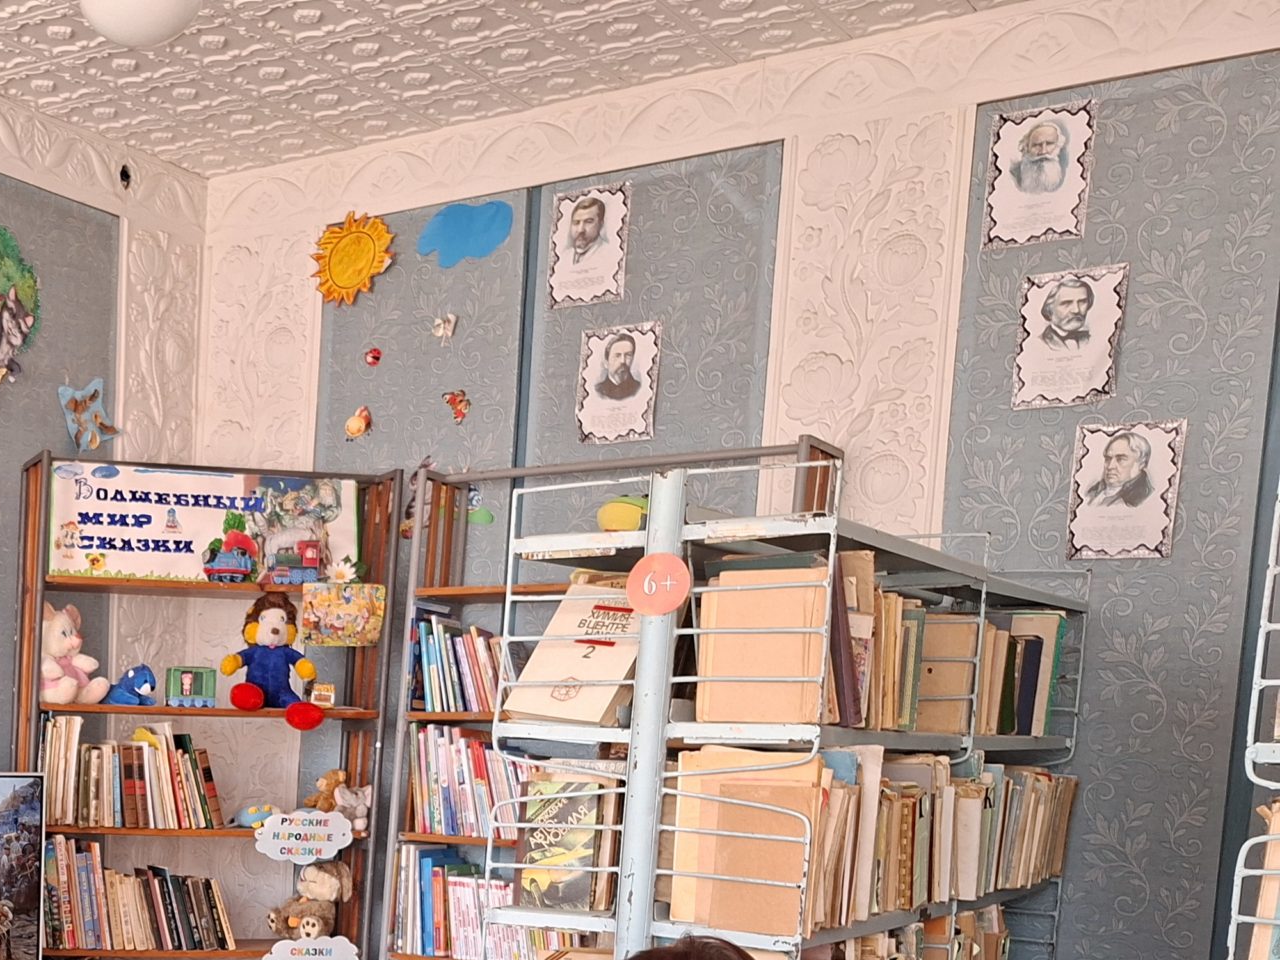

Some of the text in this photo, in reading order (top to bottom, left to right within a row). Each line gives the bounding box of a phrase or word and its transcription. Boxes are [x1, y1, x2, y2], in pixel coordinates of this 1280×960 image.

[75, 477, 266, 513] ВОЛШЕБНЫЙ
[77, 512, 152, 528] МИР
[77, 535, 195, 554] СКАЗКИ
[643, 572, 677, 595] 6+
[582, 646, 596, 659] 2
[280, 817, 330, 828] РУССКИЕ
[272, 831, 334, 843] НАРОДНЫЕ
[279, 846, 323, 856] СКАЗКИ
[290, 947, 333, 957] СКАЗКИ
